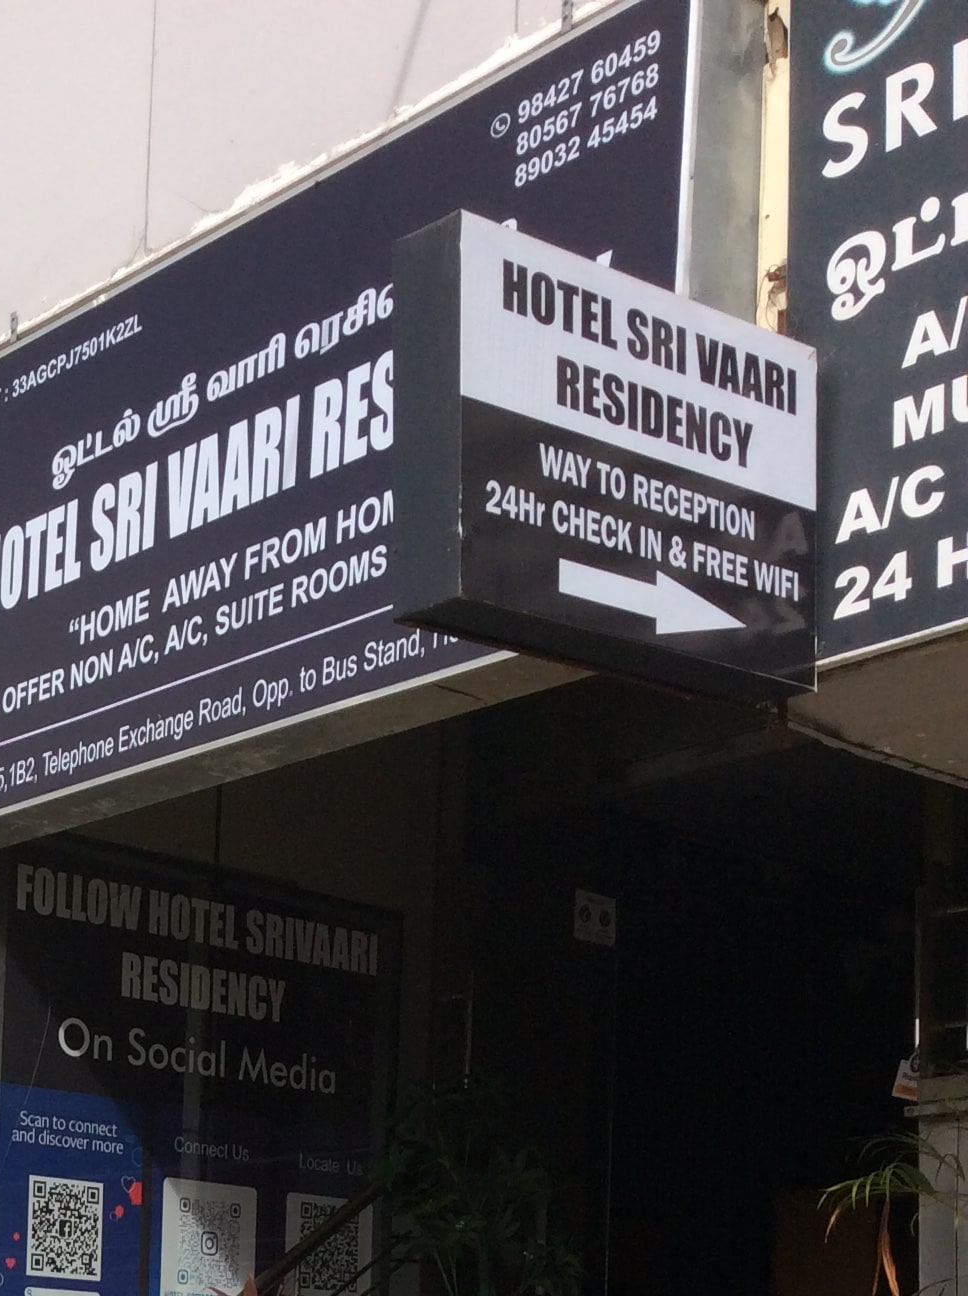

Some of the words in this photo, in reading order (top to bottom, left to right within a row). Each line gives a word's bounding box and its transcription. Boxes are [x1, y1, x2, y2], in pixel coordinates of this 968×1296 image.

[516, 101, 582, 155] 80567
[590, 63, 659, 118] 76768
[517, 69, 584, 124] 98427
[591, 30, 661, 84] 60459
[514, 136, 580, 187] 89032
[587, 96, 658, 149] 45454
[11, 314, 143, 398] 33AGCPJ7501K2ZL
[206, 332, 287, 402] வாரி
[503, 258, 618, 351] HOTEL
[627, 308, 687, 375] SRI
[695, 332, 797, 416] VAARI
[556, 355, 753, 468] RESIDENCY
[90, 461, 159, 572] SRI
[168, 394, 301, 540] VAARI
[309, 349, 394, 480] RES
[539, 443, 592, 489] WAY
[596, 461, 626, 500] TO
[633, 474, 755, 541] RECEPTION
[835, 465, 945, 544] A/C
[162, 552, 238, 612] AWAY
[244, 516, 327, 580] FROM
[485, 480, 546, 527] 24Hr
[552, 500, 633, 553] CHECK
[640, 526, 663, 562] IN
[669, 536, 687, 570] &
[693, 541, 749, 587] FREE
[754, 559, 799, 602] WIFI
[833, 550, 912, 620] 24
[2, 668, 64, 713] OFFER
[70, 648, 113, 690] NON
[118, 634, 159, 672] A/C,
[165, 615, 208, 655] A/C,
[215, 583, 284, 635] SUITE
[291, 545, 388, 608] ROOMS
[42, 736, 114, 775] Telephone
[119, 710, 193, 752] Exchange
[199, 686, 246, 726] Road,
[252, 679, 293, 709] Opp.
[300, 665, 317, 693] to
[322, 656, 358, 685] Bus
[364, 628, 425, 672] Stand,
[17, 863, 142, 930] FOLLOW
[149, 889, 238, 949] HOTEL
[121, 951, 286, 1022] RESIDENCY
[58, 1017, 113, 1061] On
[127, 1027, 227, 1078] Social
[238, 1045, 336, 1095] Media
[11, 1128, 36, 1143] and
[38, 1130, 90, 1150] discover
[92, 1139, 124, 1154] more
[19, 1110, 50, 1128] Scan
[52, 1115, 66, 1130] to
[68, 1120, 118, 1137] connect
[174, 1136, 229, 1159] Connect
[232, 1143, 250, 1161] Us
[299, 1153, 340, 1173] Locate
